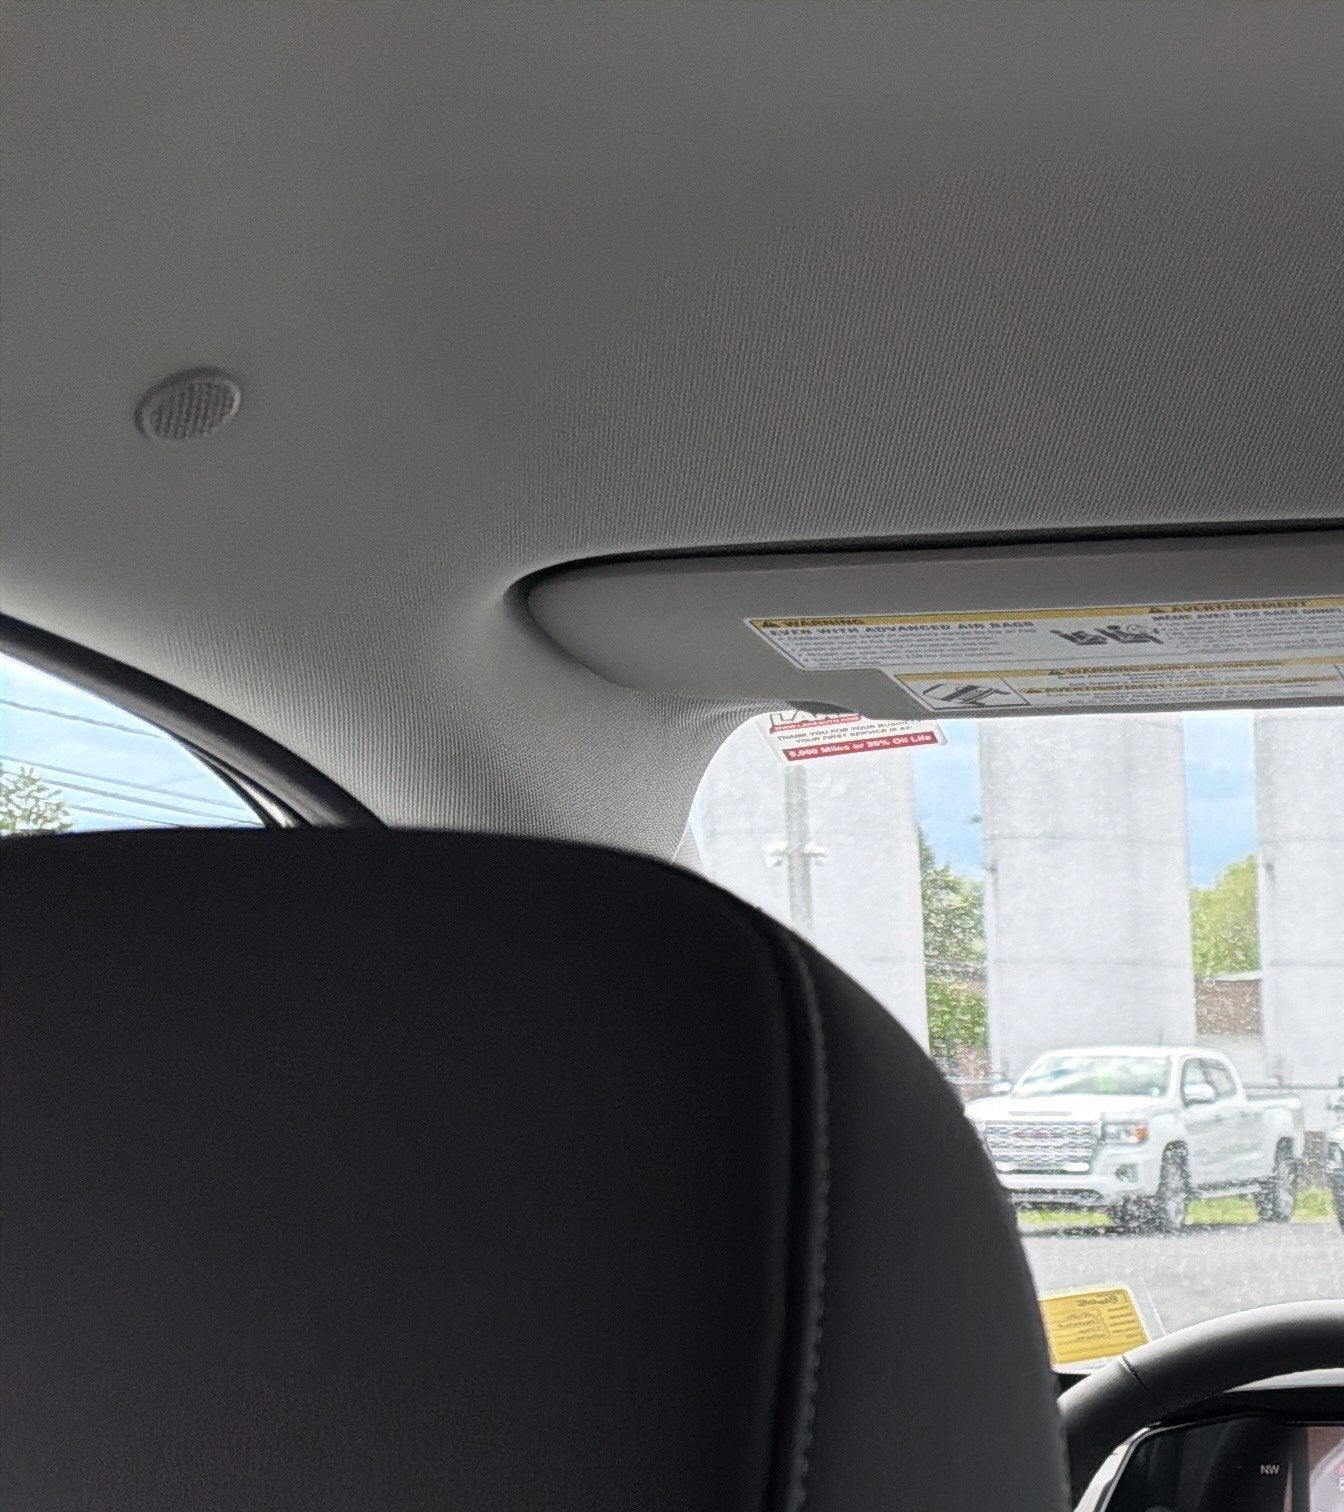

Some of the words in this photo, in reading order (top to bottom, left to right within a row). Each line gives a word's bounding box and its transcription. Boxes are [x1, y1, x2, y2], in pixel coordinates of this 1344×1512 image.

[819, 627, 858, 635] WITH
[865, 624, 950, 633] ADVANCED
[851, 724, 876, 732] YOUR
[820, 744, 851, 754] Miles
[909, 734, 933, 743] Life
[1260, 1465, 1280, 1475] NW
